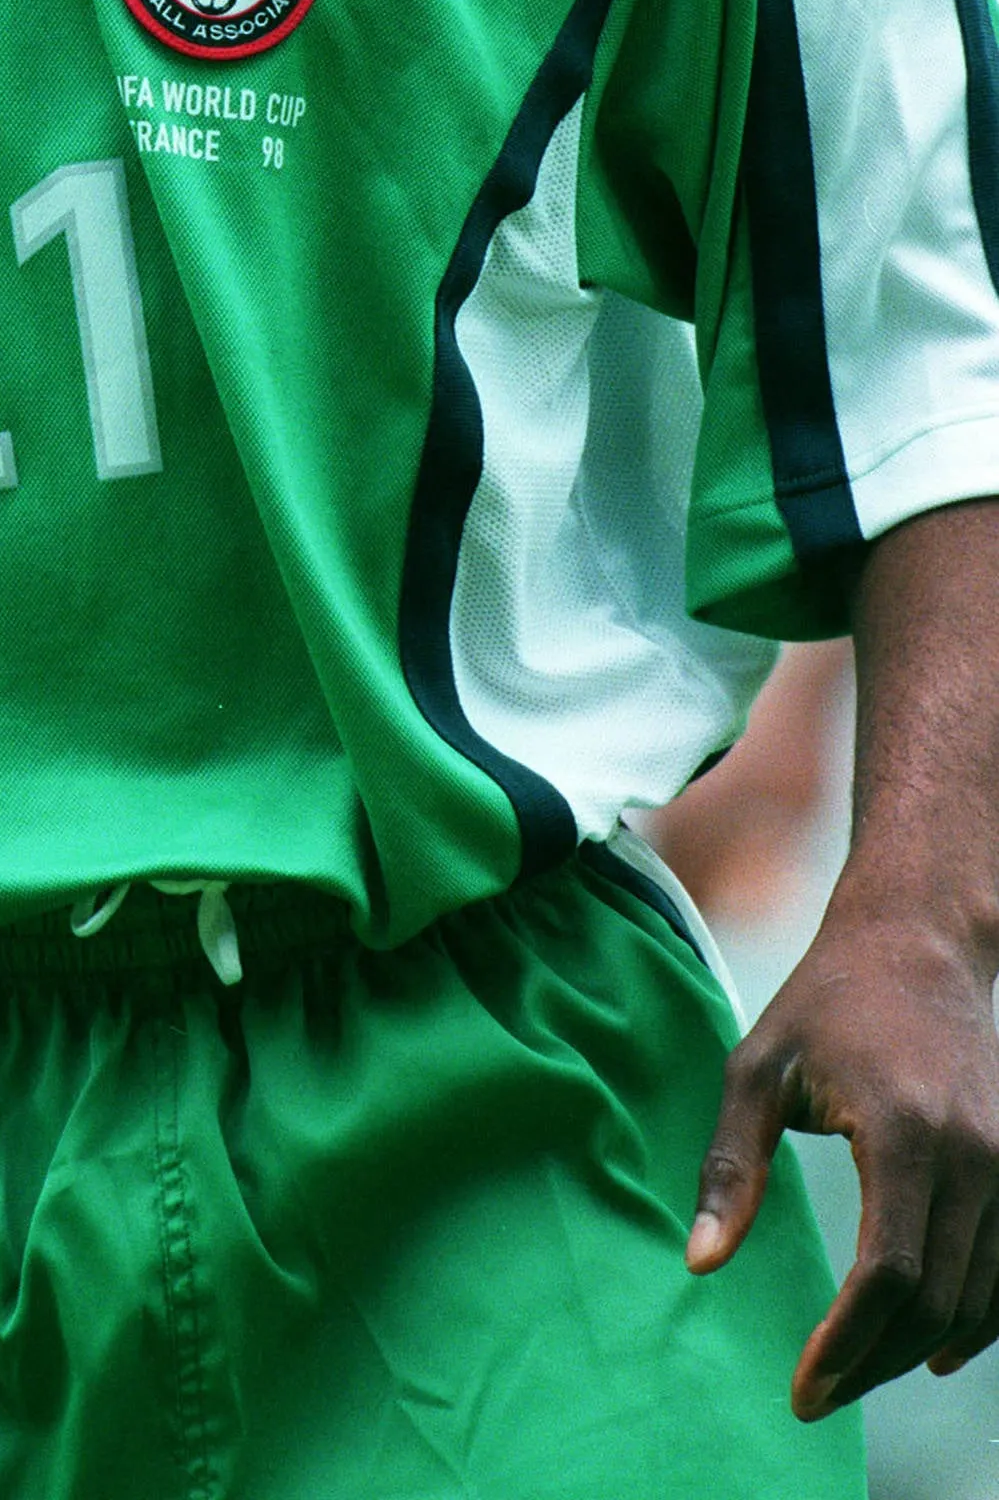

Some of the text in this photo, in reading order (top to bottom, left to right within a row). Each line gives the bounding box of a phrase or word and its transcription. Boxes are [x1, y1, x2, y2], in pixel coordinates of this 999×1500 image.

[161, 79, 256, 121] WORLD
[266, 93, 307, 128] CUP
[128, 119, 284, 169] RANCE 98
